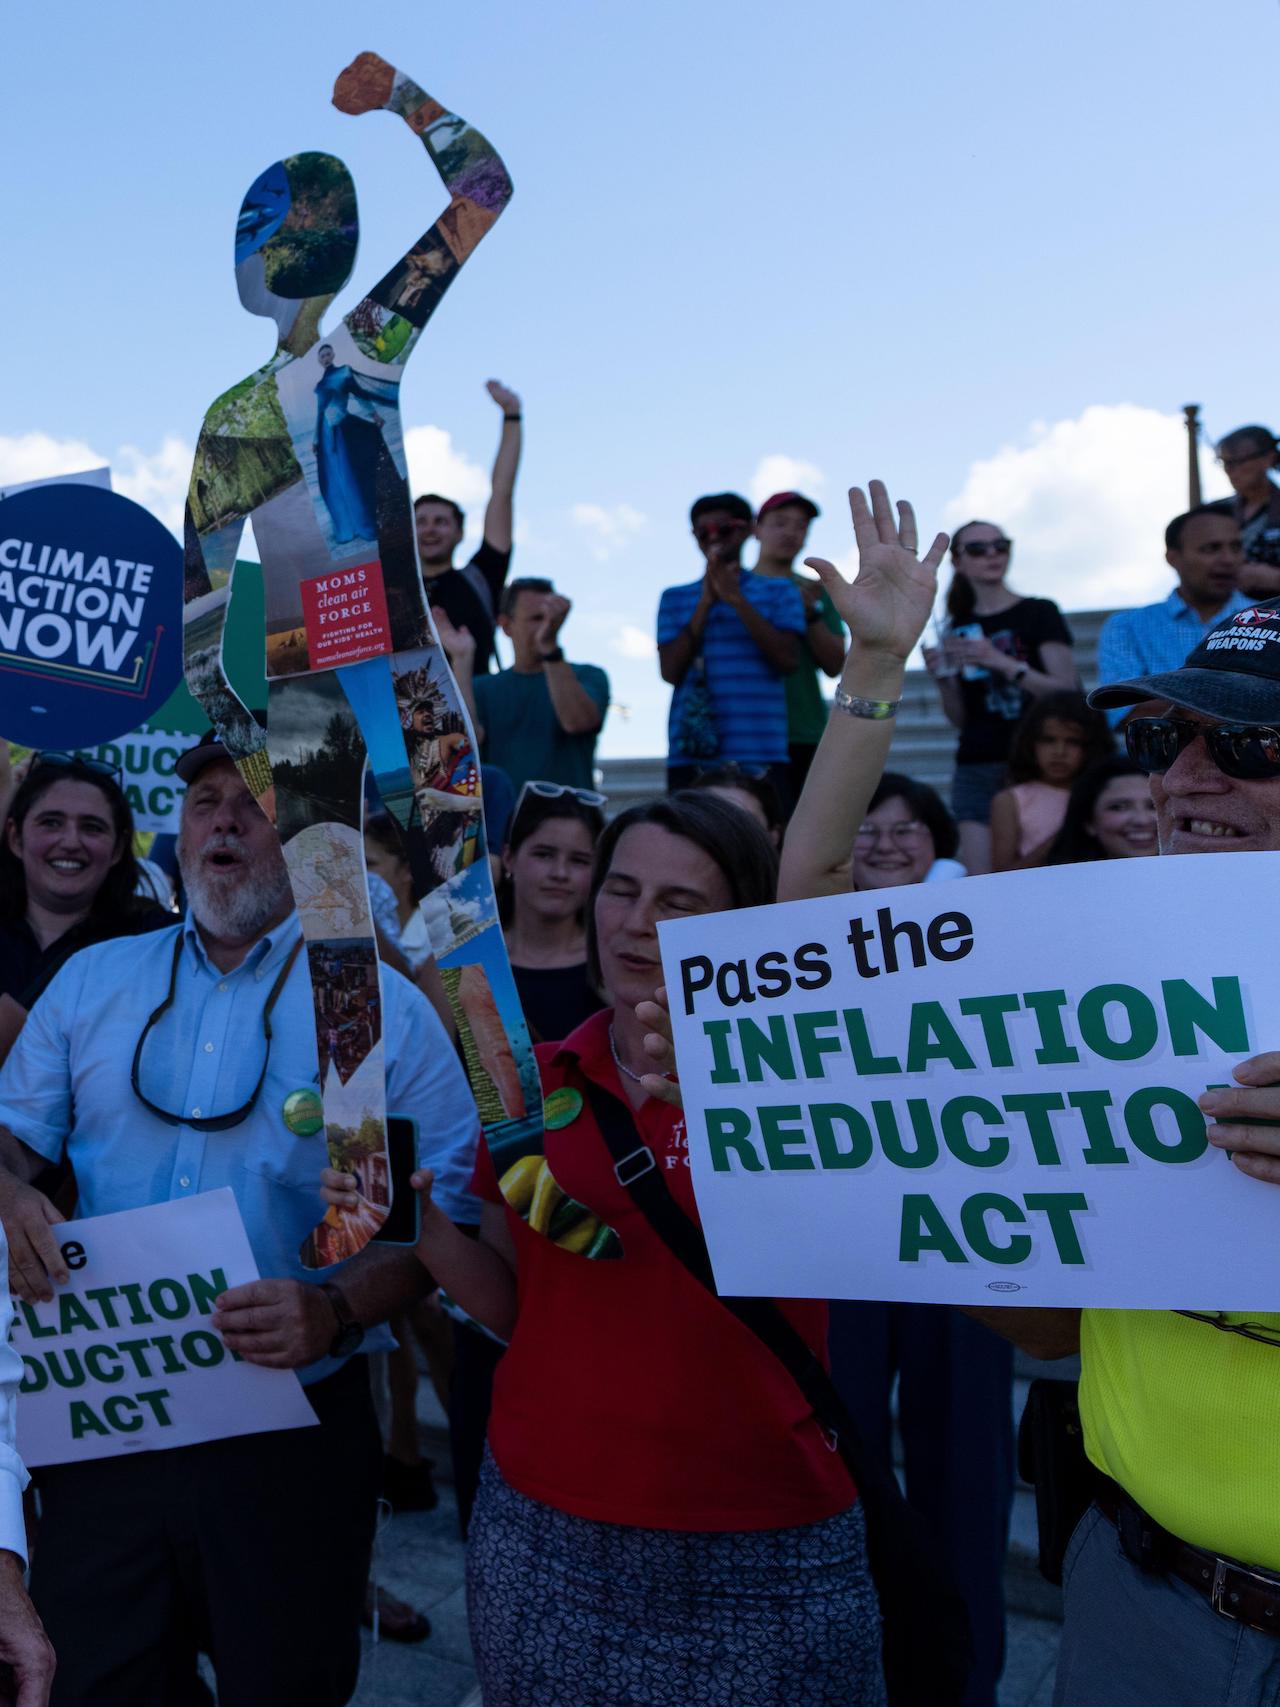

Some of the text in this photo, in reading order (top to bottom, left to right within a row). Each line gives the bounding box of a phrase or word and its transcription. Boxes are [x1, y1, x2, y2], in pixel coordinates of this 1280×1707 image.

[316, 569, 367, 593] MOMS
[318, 585, 369, 609] clean air
[319, 601, 372, 625] FORCE
[316, 639, 333, 649] OUR
[355, 626, 384, 639] HEALTH
[322, 621, 374, 640] FIGHTING FOR
[1206, 637, 1267, 651] WEAPONS
[680, 907, 975, 1016] Pass the
[704, 975, 1251, 1085] INFLATION
[704, 1085, 1265, 1172] REDUCTIO
[898, 1191, 1089, 1264] ACT
[69, 1388, 173, 1440] ACT
